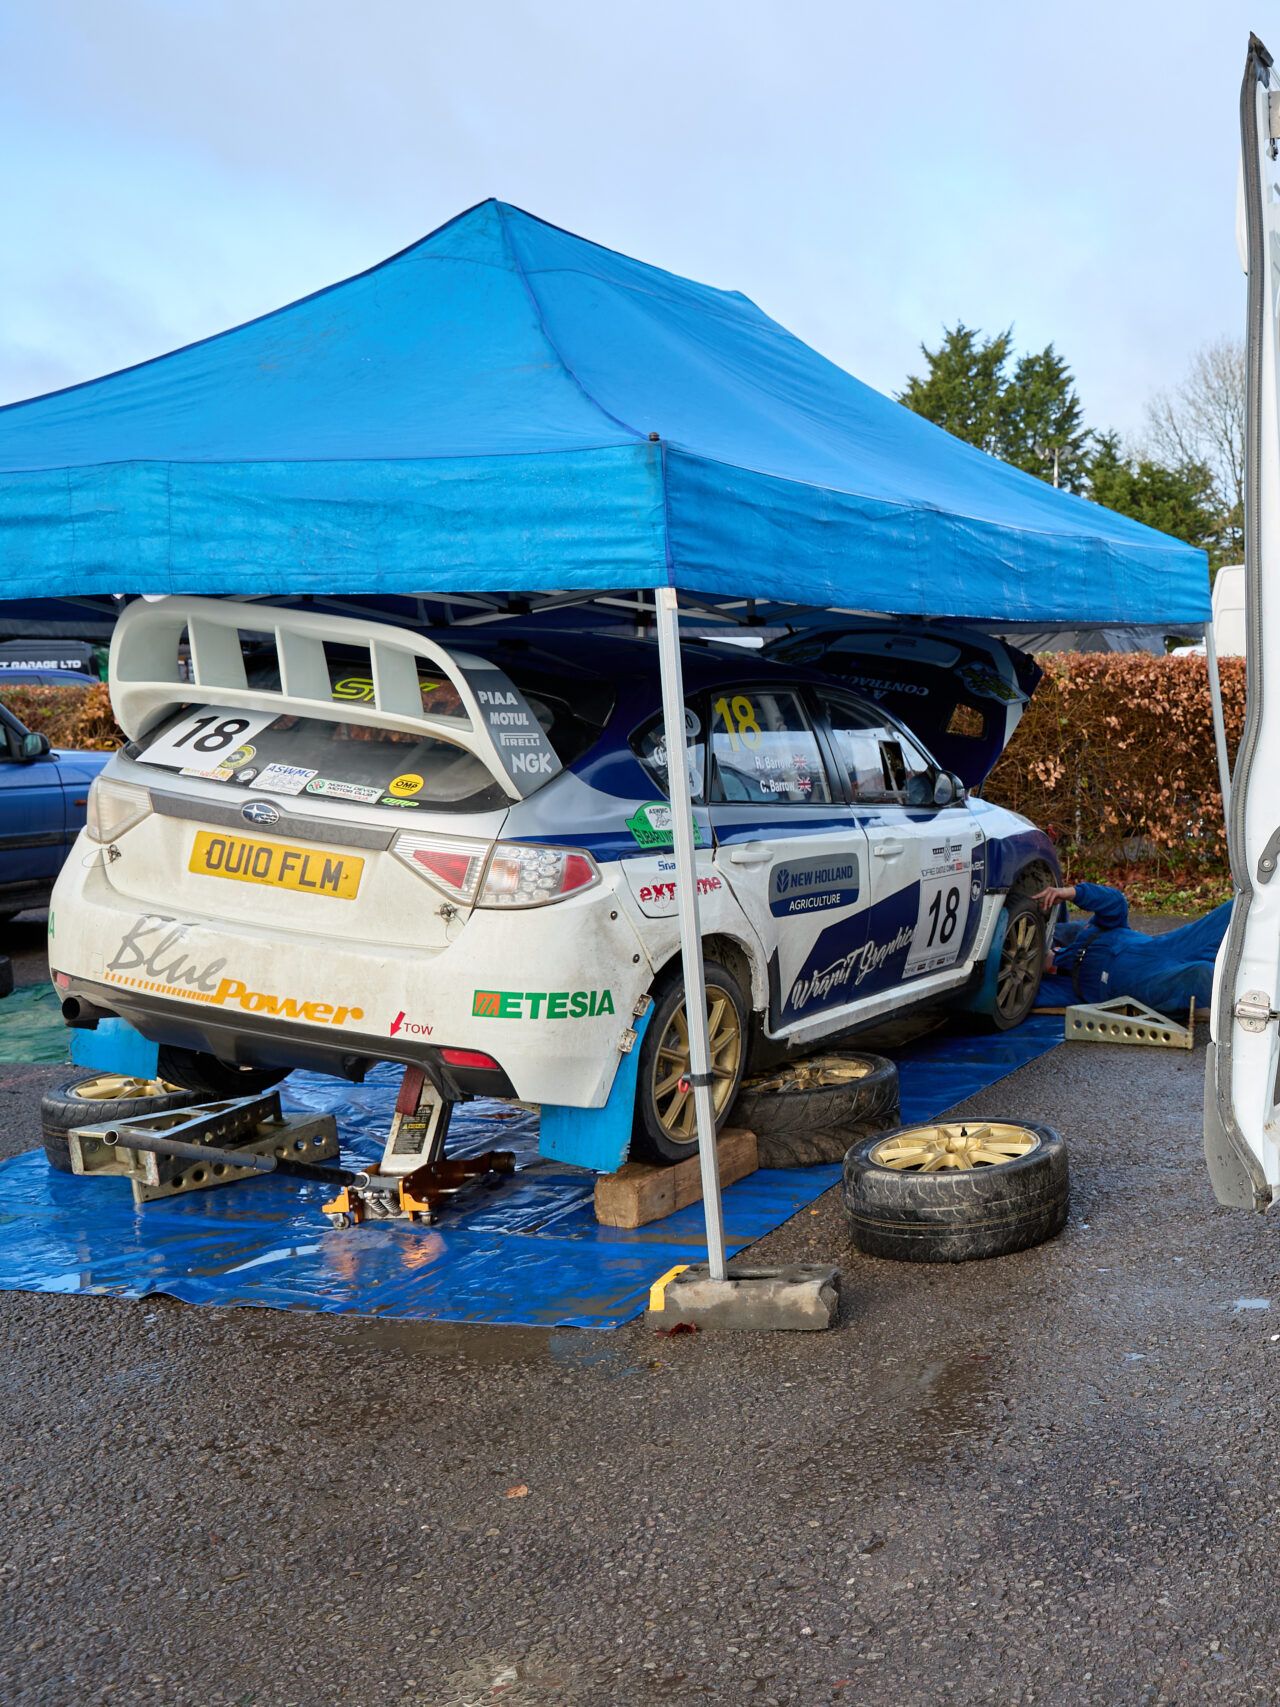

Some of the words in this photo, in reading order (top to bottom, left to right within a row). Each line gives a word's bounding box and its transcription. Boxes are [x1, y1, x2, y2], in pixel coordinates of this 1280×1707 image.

[11, 660, 58, 669] GARAGE
[60, 660, 82, 669] LTD
[841, 674, 930, 697] CONTRAC
[477, 690, 519, 706] PIAA
[489, 711, 530, 726] MOTUL
[713, 695, 764, 752] 18
[172, 715, 251, 753] 18
[499, 732, 541, 747] PIRELLI
[267, 762, 315, 779] ASWMC
[511, 751, 553, 774] NGK
[754, 756, 763, 769] R.
[765, 756, 793, 769] Barrow
[327, 781, 353, 790] NORTH
[353, 785, 379, 795] DEVON
[327, 786, 354, 794] MOTOR
[354, 789, 374, 797] CLUB
[395, 780, 419, 790] OMP
[759, 780, 768, 793] C.
[769, 779, 796, 793] Barrow
[648, 807, 669, 815] ASWMC
[632, 827, 667, 845] SUBARU
[205, 838, 274, 879] OU10
[277, 850, 344, 892] FLM
[790, 871, 814, 888] NEW
[814, 865, 853, 885] HOLLAND
[639, 875, 723, 903] extme
[788, 893, 842, 912] AGRICULTURE
[926, 886, 961, 948] 18
[854, 925, 914, 986] Graphic
[105, 912, 228, 991] Blue
[211, 977, 364, 1026] Power
[505, 989, 615, 1020] ETESIA
[404, 1022, 434, 1036] TOW
